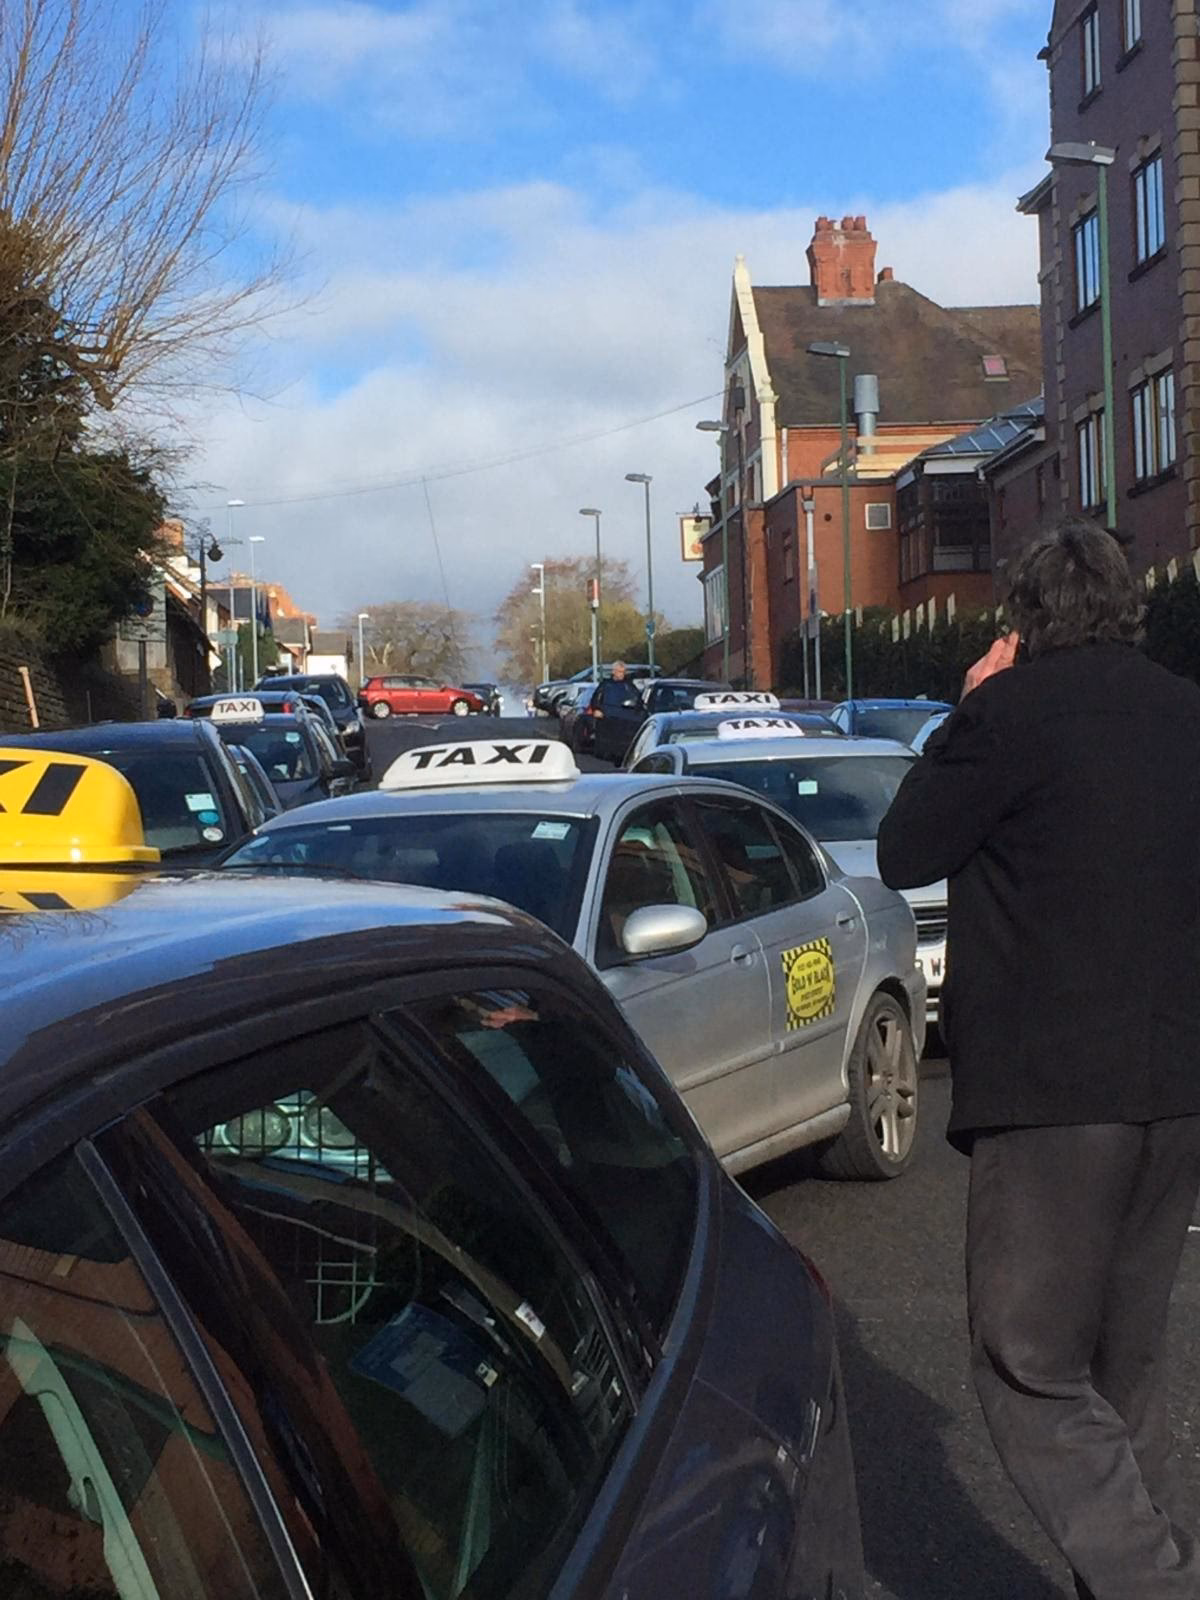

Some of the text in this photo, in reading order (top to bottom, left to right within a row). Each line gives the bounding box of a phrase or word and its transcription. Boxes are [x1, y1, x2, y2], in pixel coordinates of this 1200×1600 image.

[703, 694, 771, 704] TAXI
[218, 701, 257, 713] TAXI
[726, 719, 794, 730] TAXI
[411, 744, 550, 770] TAXI
